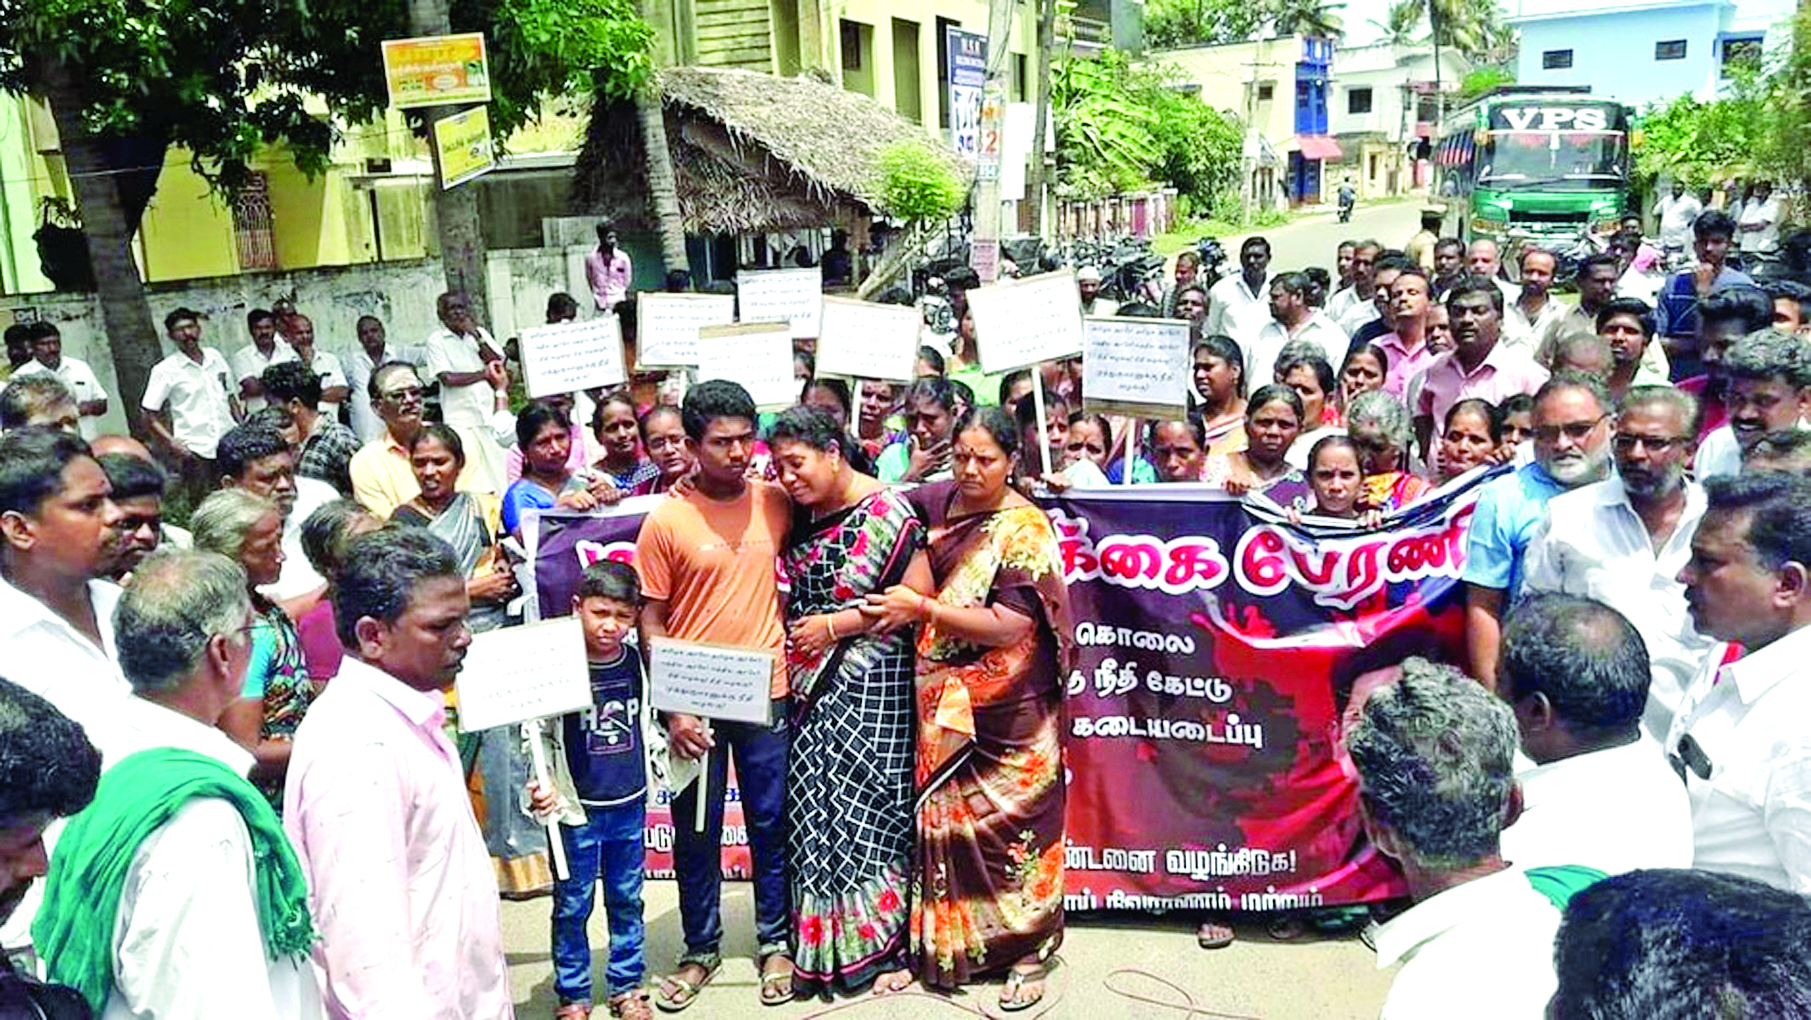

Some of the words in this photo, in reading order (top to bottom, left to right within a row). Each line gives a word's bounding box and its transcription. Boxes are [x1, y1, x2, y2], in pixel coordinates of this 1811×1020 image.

[1502, 108, 1606, 130] VPS
[1075, 622, 1196, 654] கொலை
[1094, 657, 1139, 697] நீதி
[1146, 670, 1233, 703] கேட்டு
[1072, 713, 1263, 749] கடையடைப்பு
